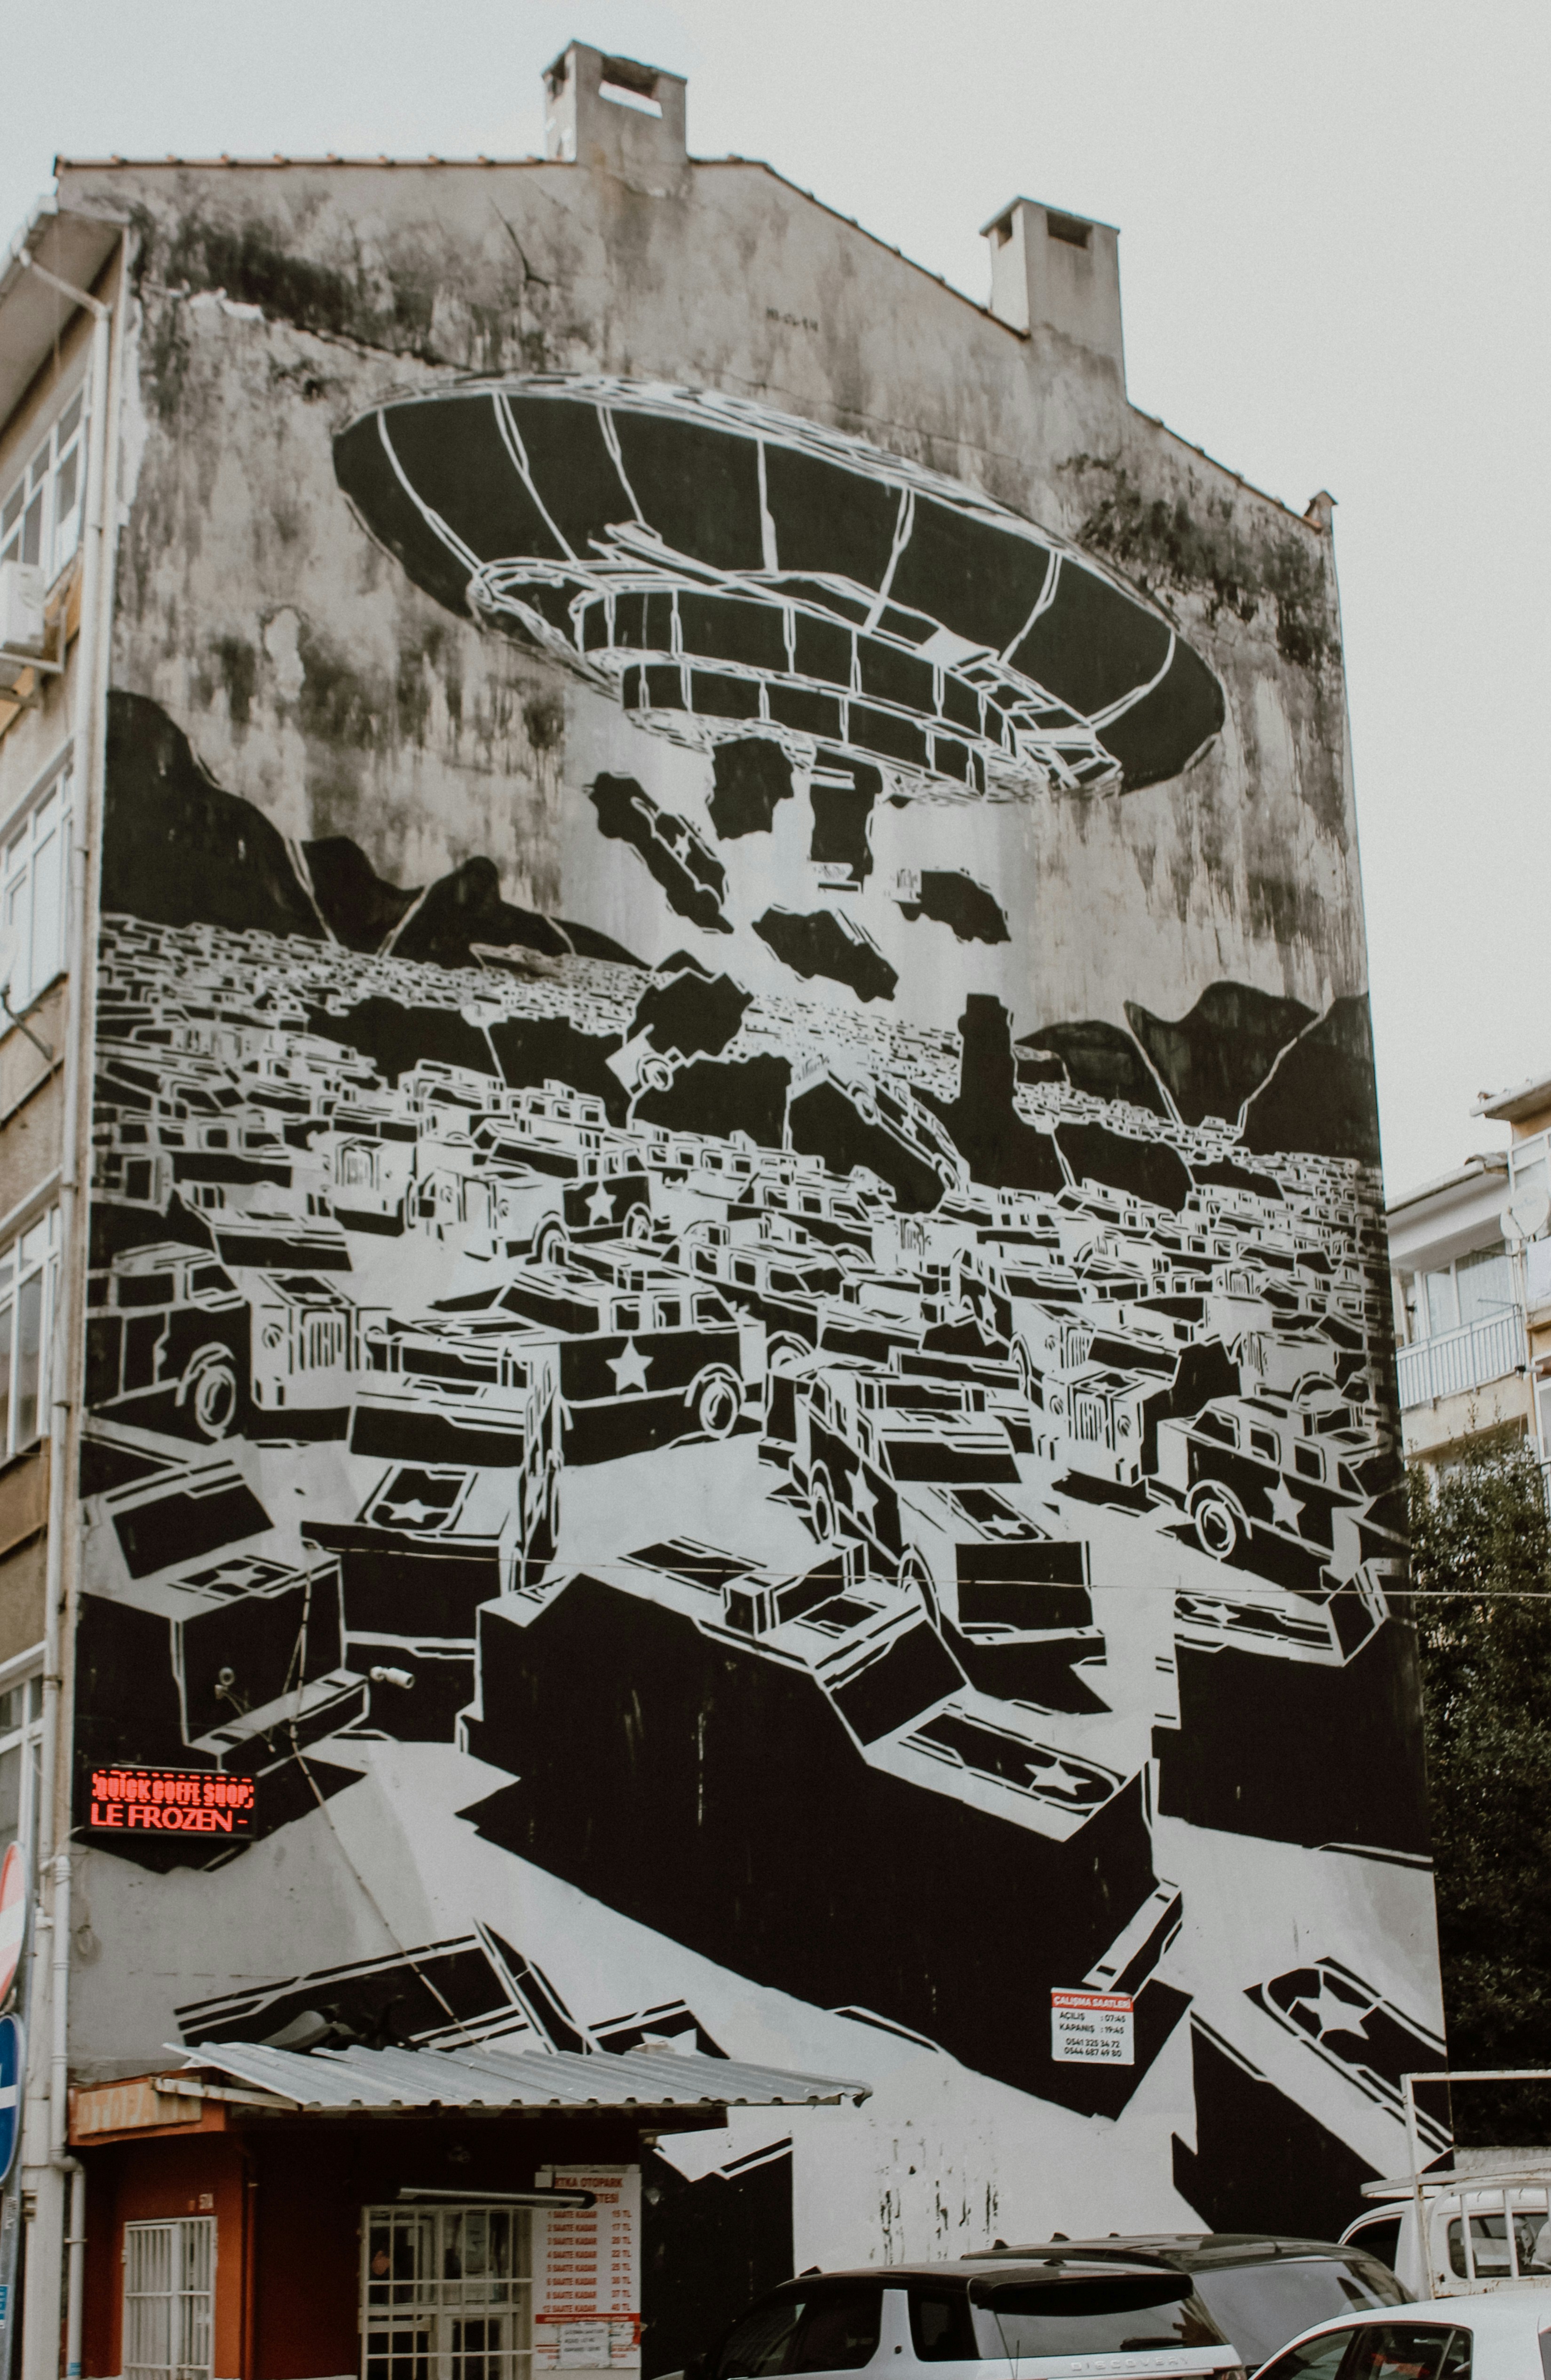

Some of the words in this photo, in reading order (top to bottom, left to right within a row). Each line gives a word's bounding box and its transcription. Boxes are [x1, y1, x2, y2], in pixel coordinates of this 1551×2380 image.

[91, 1803, 124, 1827] LE
[128, 1804, 233, 1832] FROZEN
[1053, 1996, 1091, 2007] ÇALIŞMA
[1059, 2011, 1085, 2021] AÇILIŞ
[1059, 2023, 1095, 2033] KAPANIŞ
[1070, 2356, 1190, 2372] DISCOVERY
